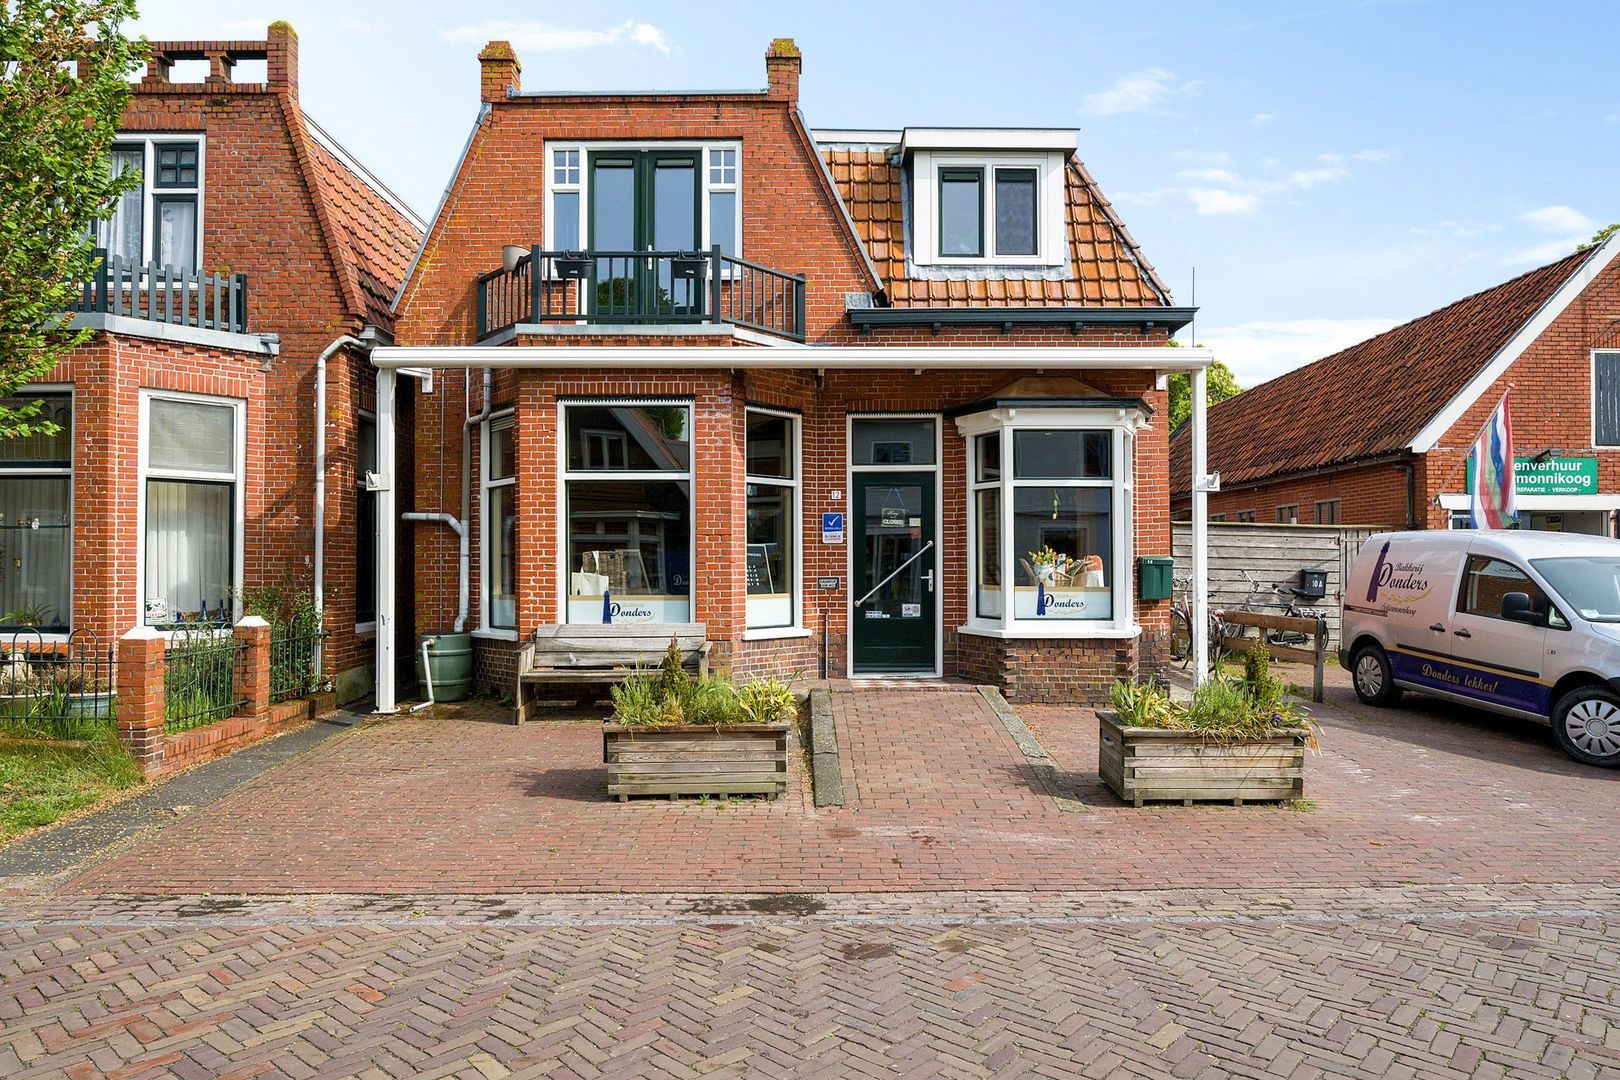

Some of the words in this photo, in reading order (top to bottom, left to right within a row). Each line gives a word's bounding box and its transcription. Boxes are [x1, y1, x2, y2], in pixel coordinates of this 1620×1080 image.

[1514, 460, 1582, 471] enverhuur
[1378, 562, 1428, 591] Donders
[1043, 593, 1084, 608] Donders
[609, 602, 652, 617] Donders
[1421, 663, 1460, 684] Donders
